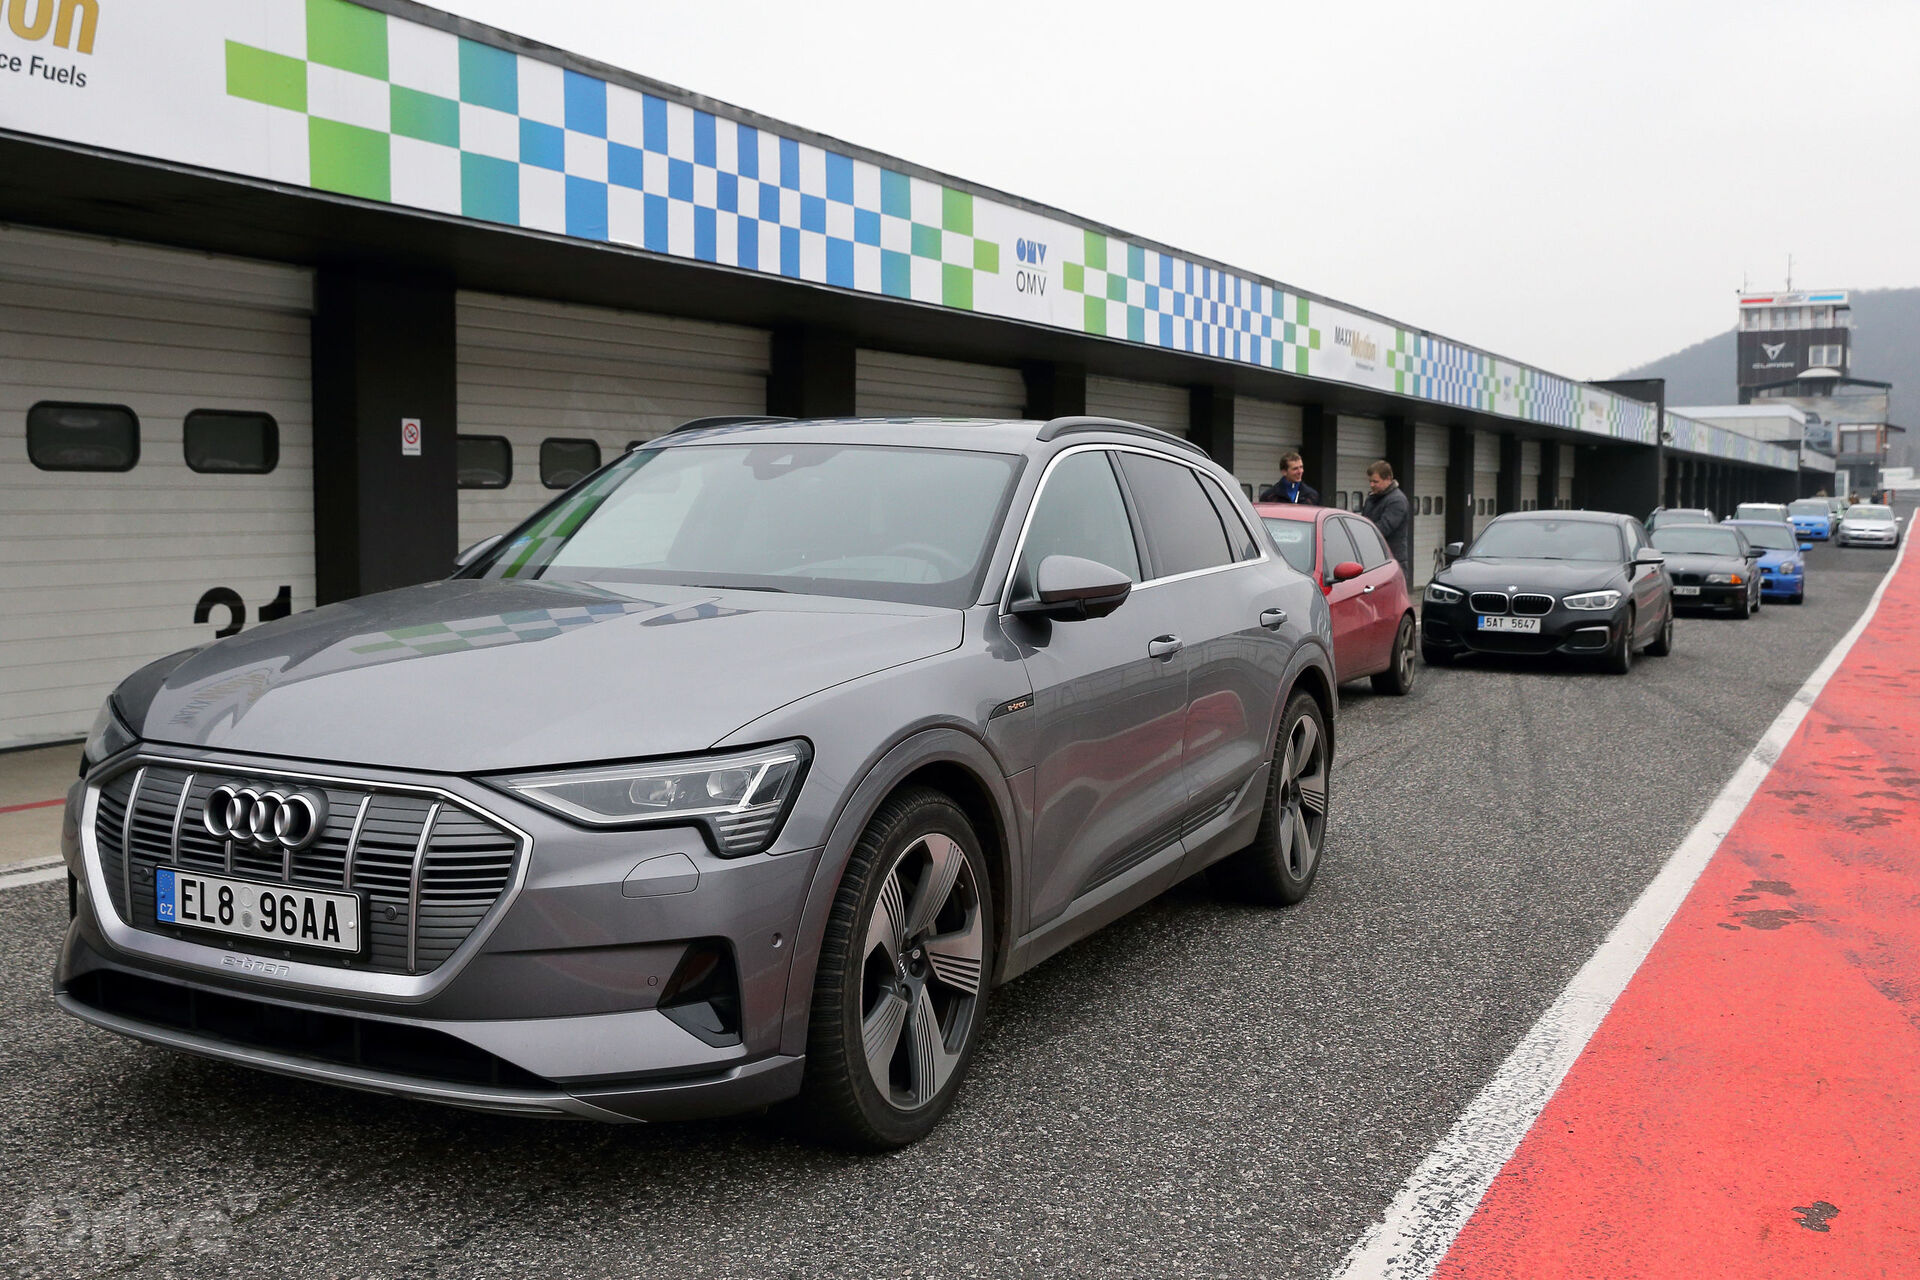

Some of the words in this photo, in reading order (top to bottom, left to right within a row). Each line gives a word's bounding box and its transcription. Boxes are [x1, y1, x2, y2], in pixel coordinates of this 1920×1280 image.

[0, 0, 99, 55] on
[29, 55, 87, 88] Fuels
[1016, 238, 1047, 265] OMV
[1016, 270, 1047, 296] OMV
[1486, 617, 1504, 628] 5AT
[1511, 618, 1536, 629] 5647
[159, 902, 174, 916] CZ
[181, 878, 234, 926] EL8
[259, 891, 341, 943] 96AA
